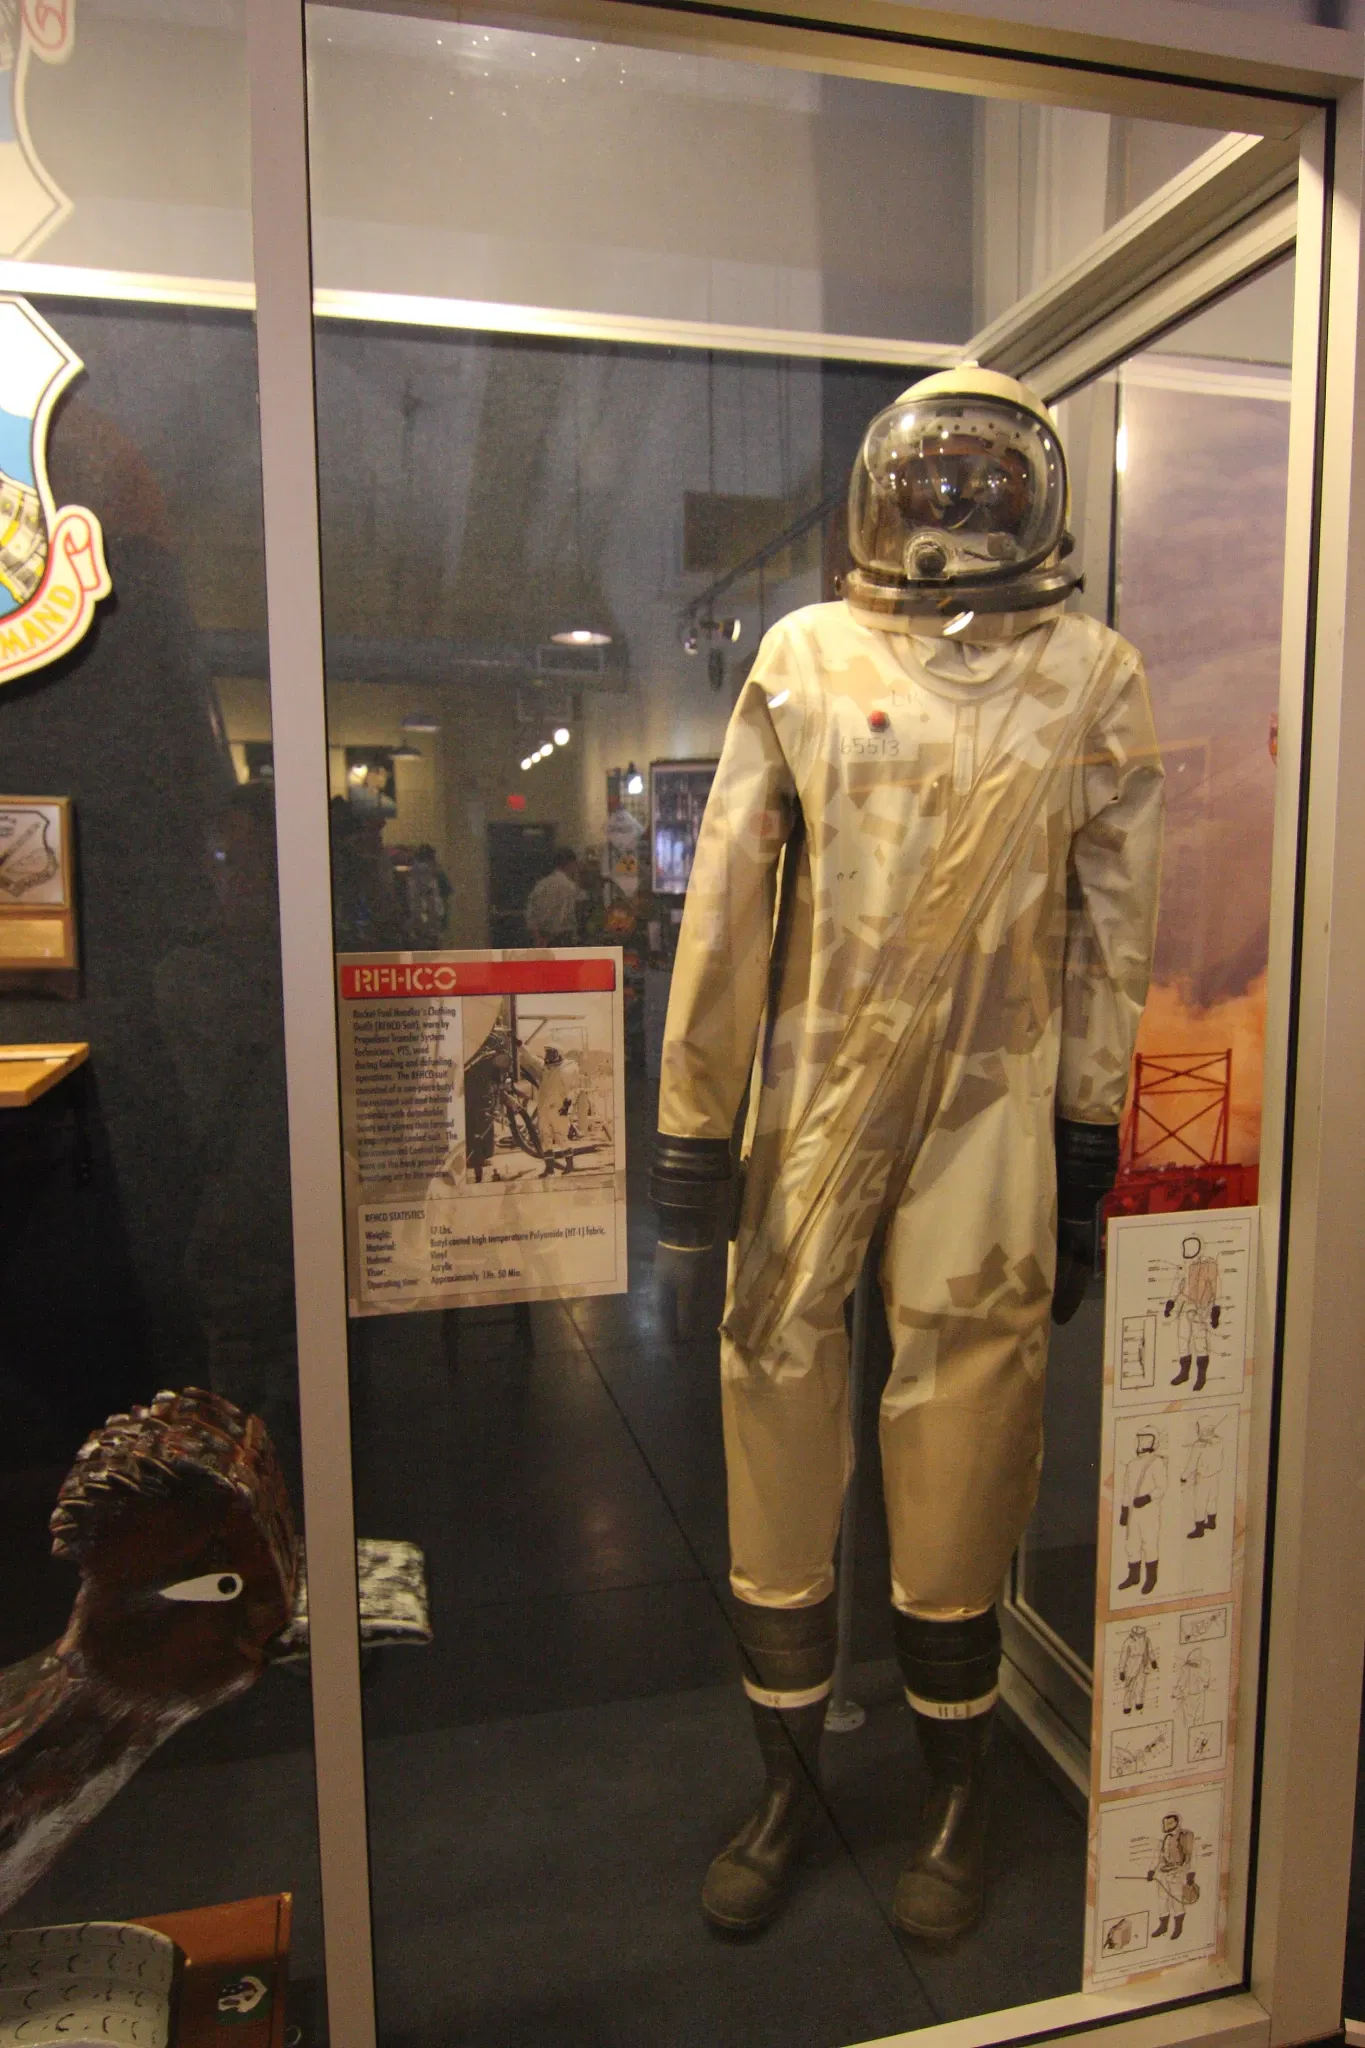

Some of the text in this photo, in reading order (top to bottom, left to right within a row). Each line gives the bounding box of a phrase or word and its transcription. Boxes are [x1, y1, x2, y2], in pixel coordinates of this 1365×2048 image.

[354, 966, 457, 993] RFHCO
[428, 1006, 457, 1018] Clothing
[441, 1020, 450, 1031] by
[420, 1032, 445, 1042] System
[397, 1071, 410, 1080] The
[389, 1210, 426, 1221] STATISTICS
[471, 1233, 488, 1247] high
[488, 1233, 529, 1244] temperature
[529, 1228, 564, 1242] Polyamide
[431, 1271, 479, 1285] Approximately
